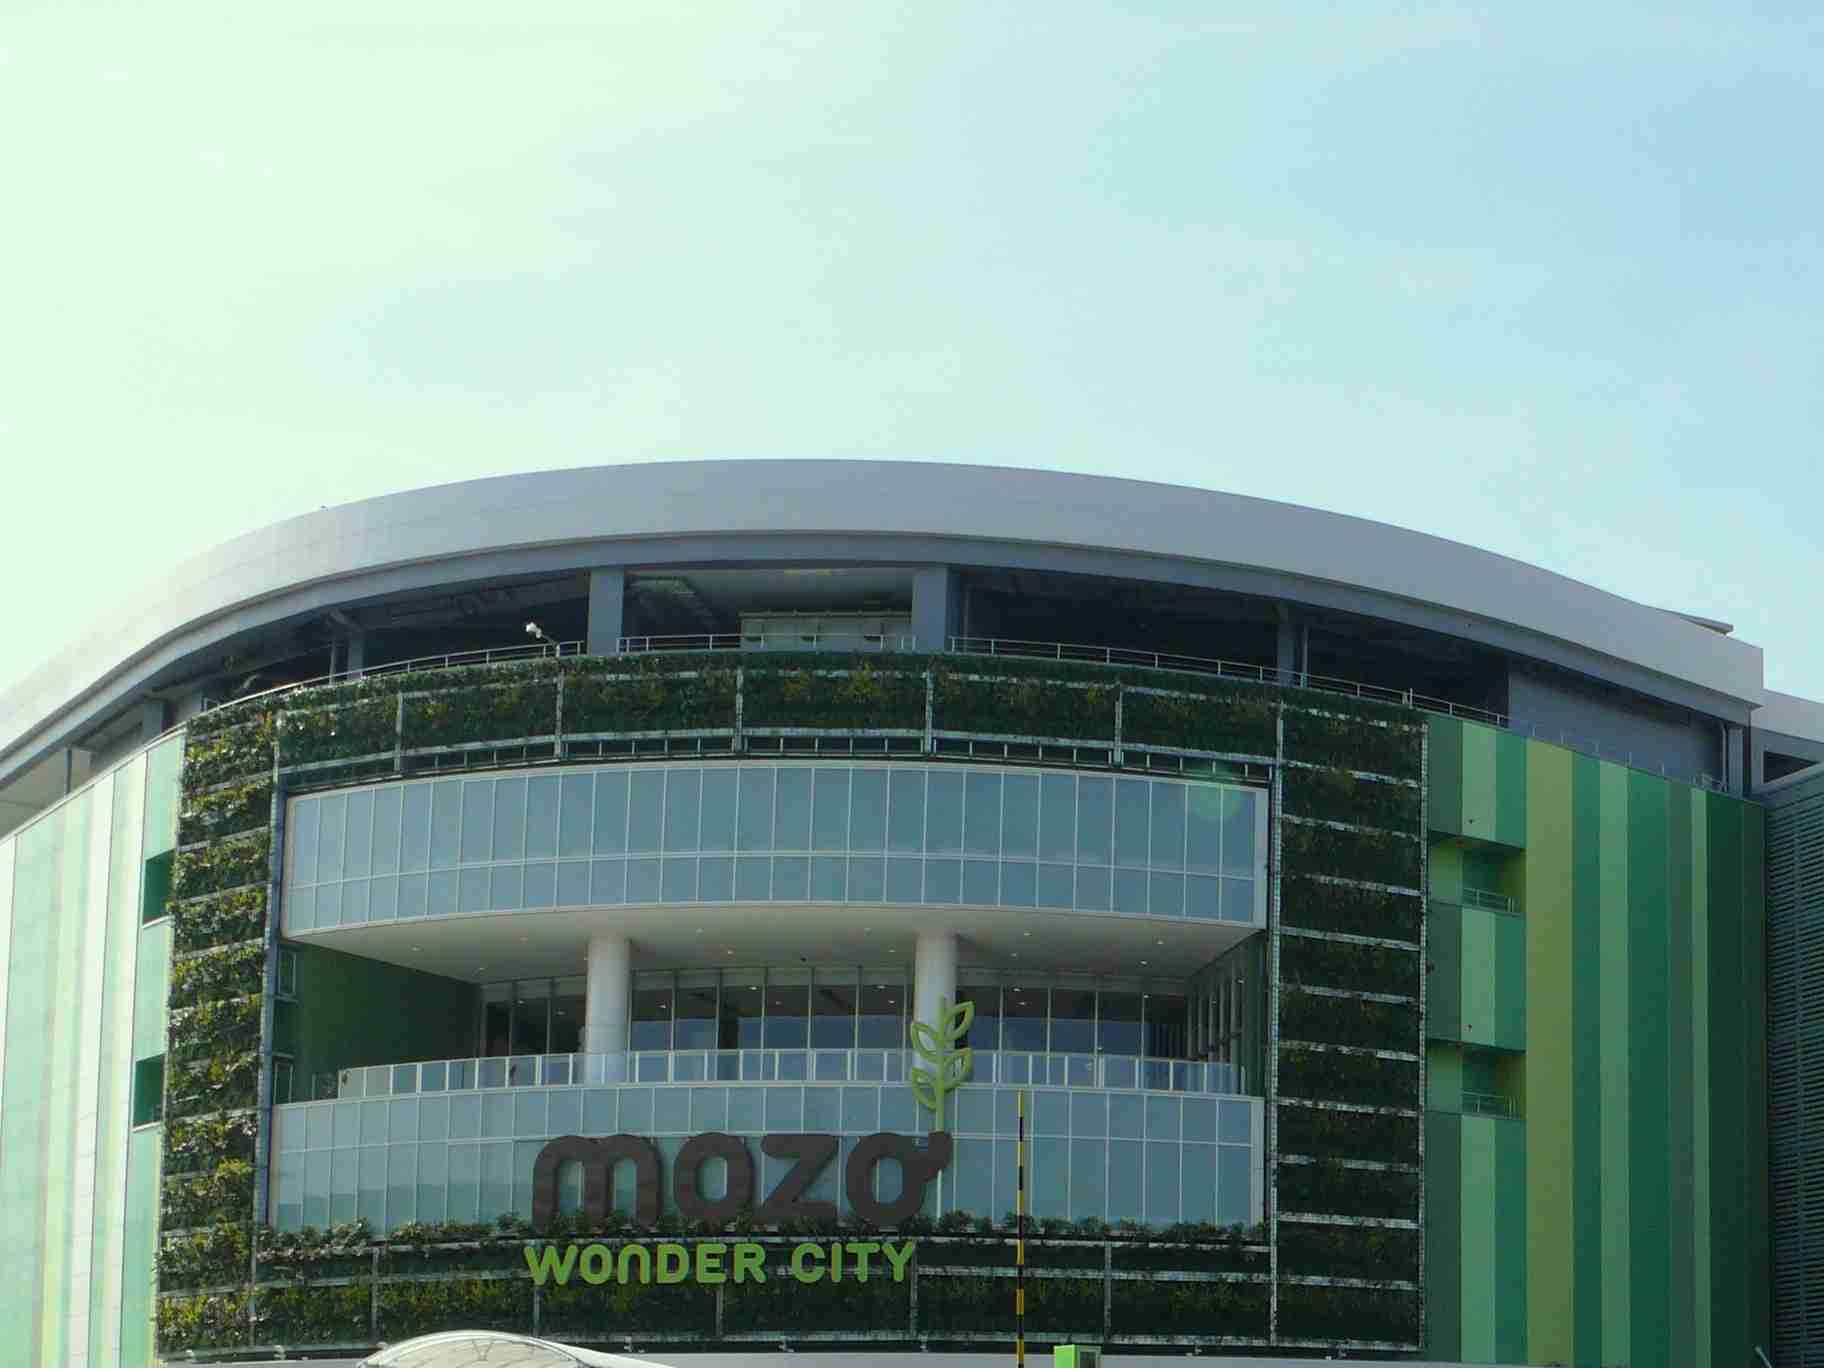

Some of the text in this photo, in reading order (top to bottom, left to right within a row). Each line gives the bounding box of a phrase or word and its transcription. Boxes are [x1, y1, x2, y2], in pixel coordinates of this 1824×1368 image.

[532, 1131, 954, 1230] mozo
[524, 1241, 917, 1286] WONDER CITY
